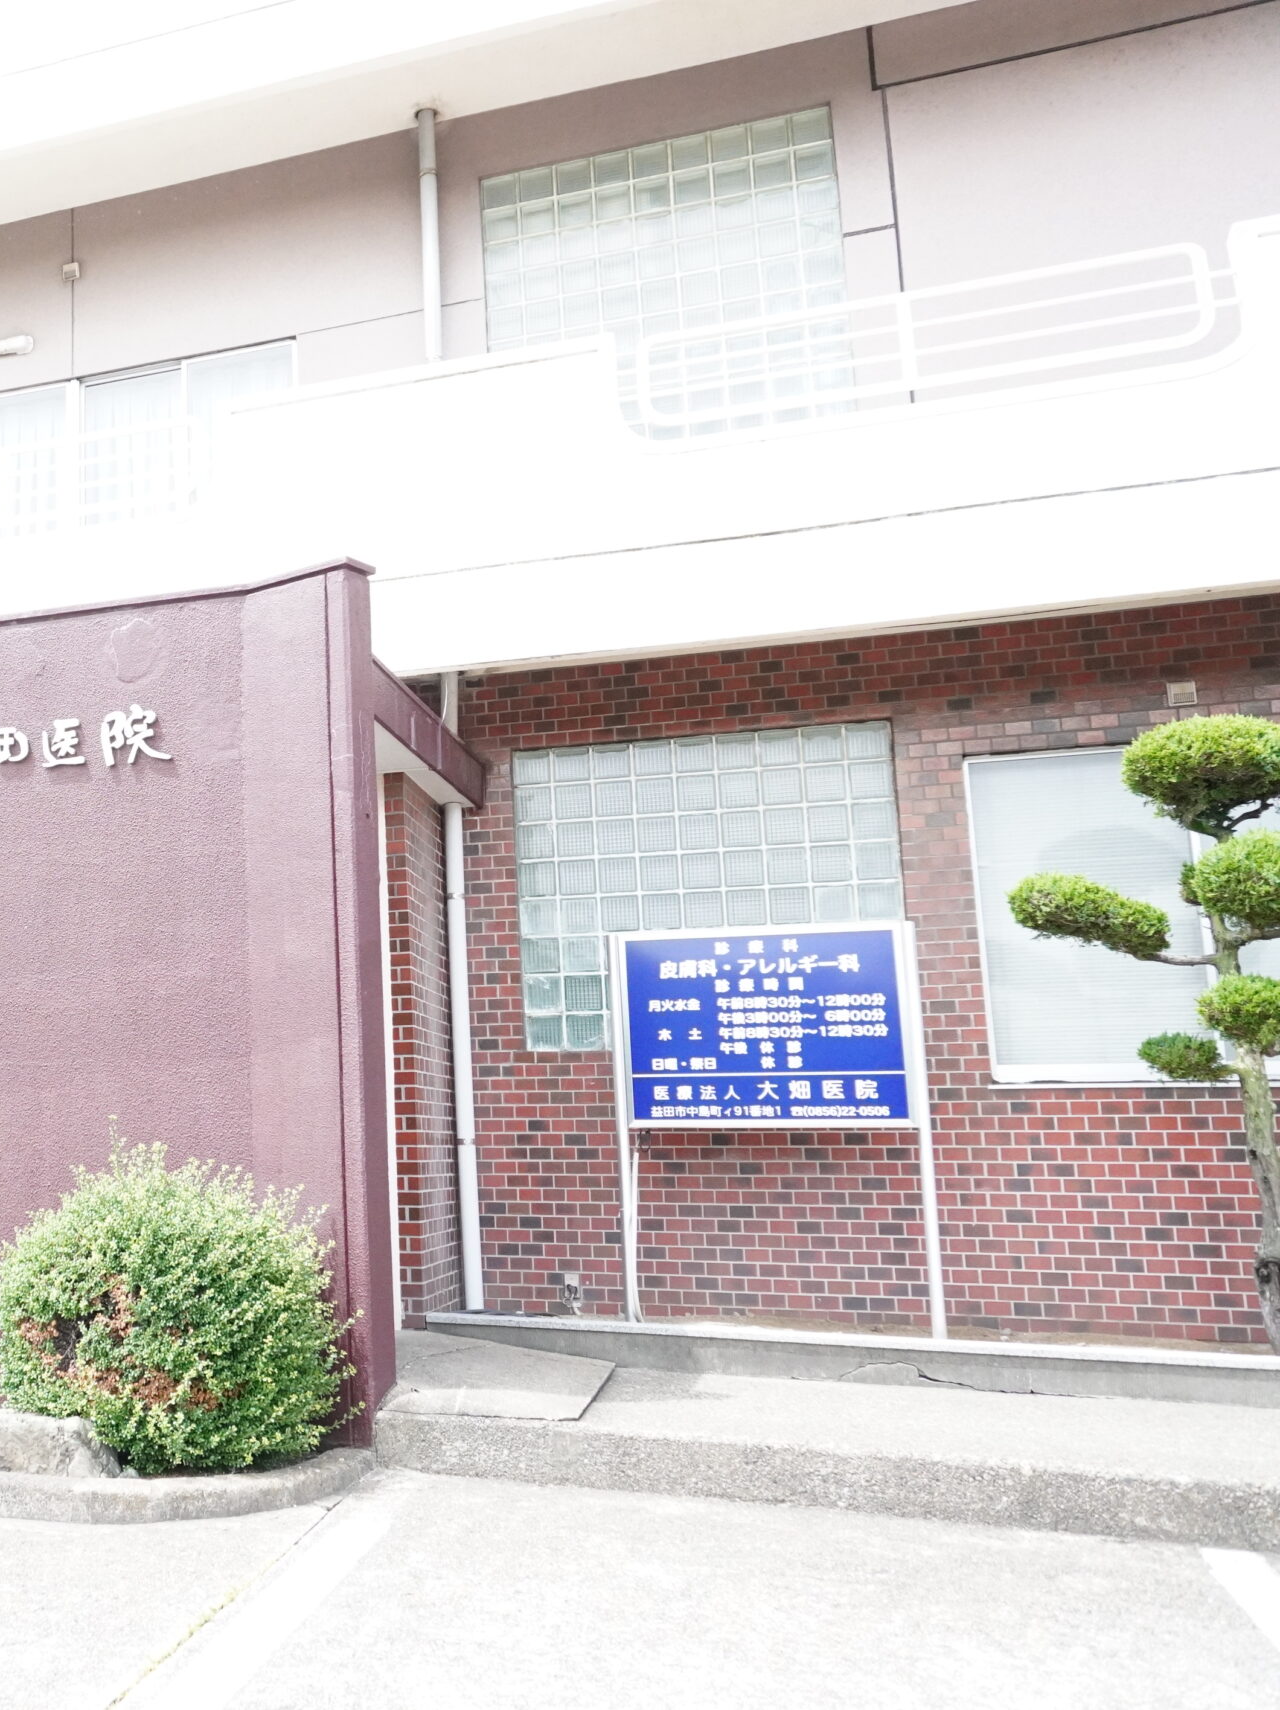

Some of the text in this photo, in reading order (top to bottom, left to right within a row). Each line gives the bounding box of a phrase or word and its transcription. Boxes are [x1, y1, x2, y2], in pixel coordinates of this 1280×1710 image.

[660, 954, 860, 979] 皮膚科・アレルギー科
[649, 999, 701, 1012] 月火水金
[654, 1080, 878, 1100] 医療法人 大畑医院
